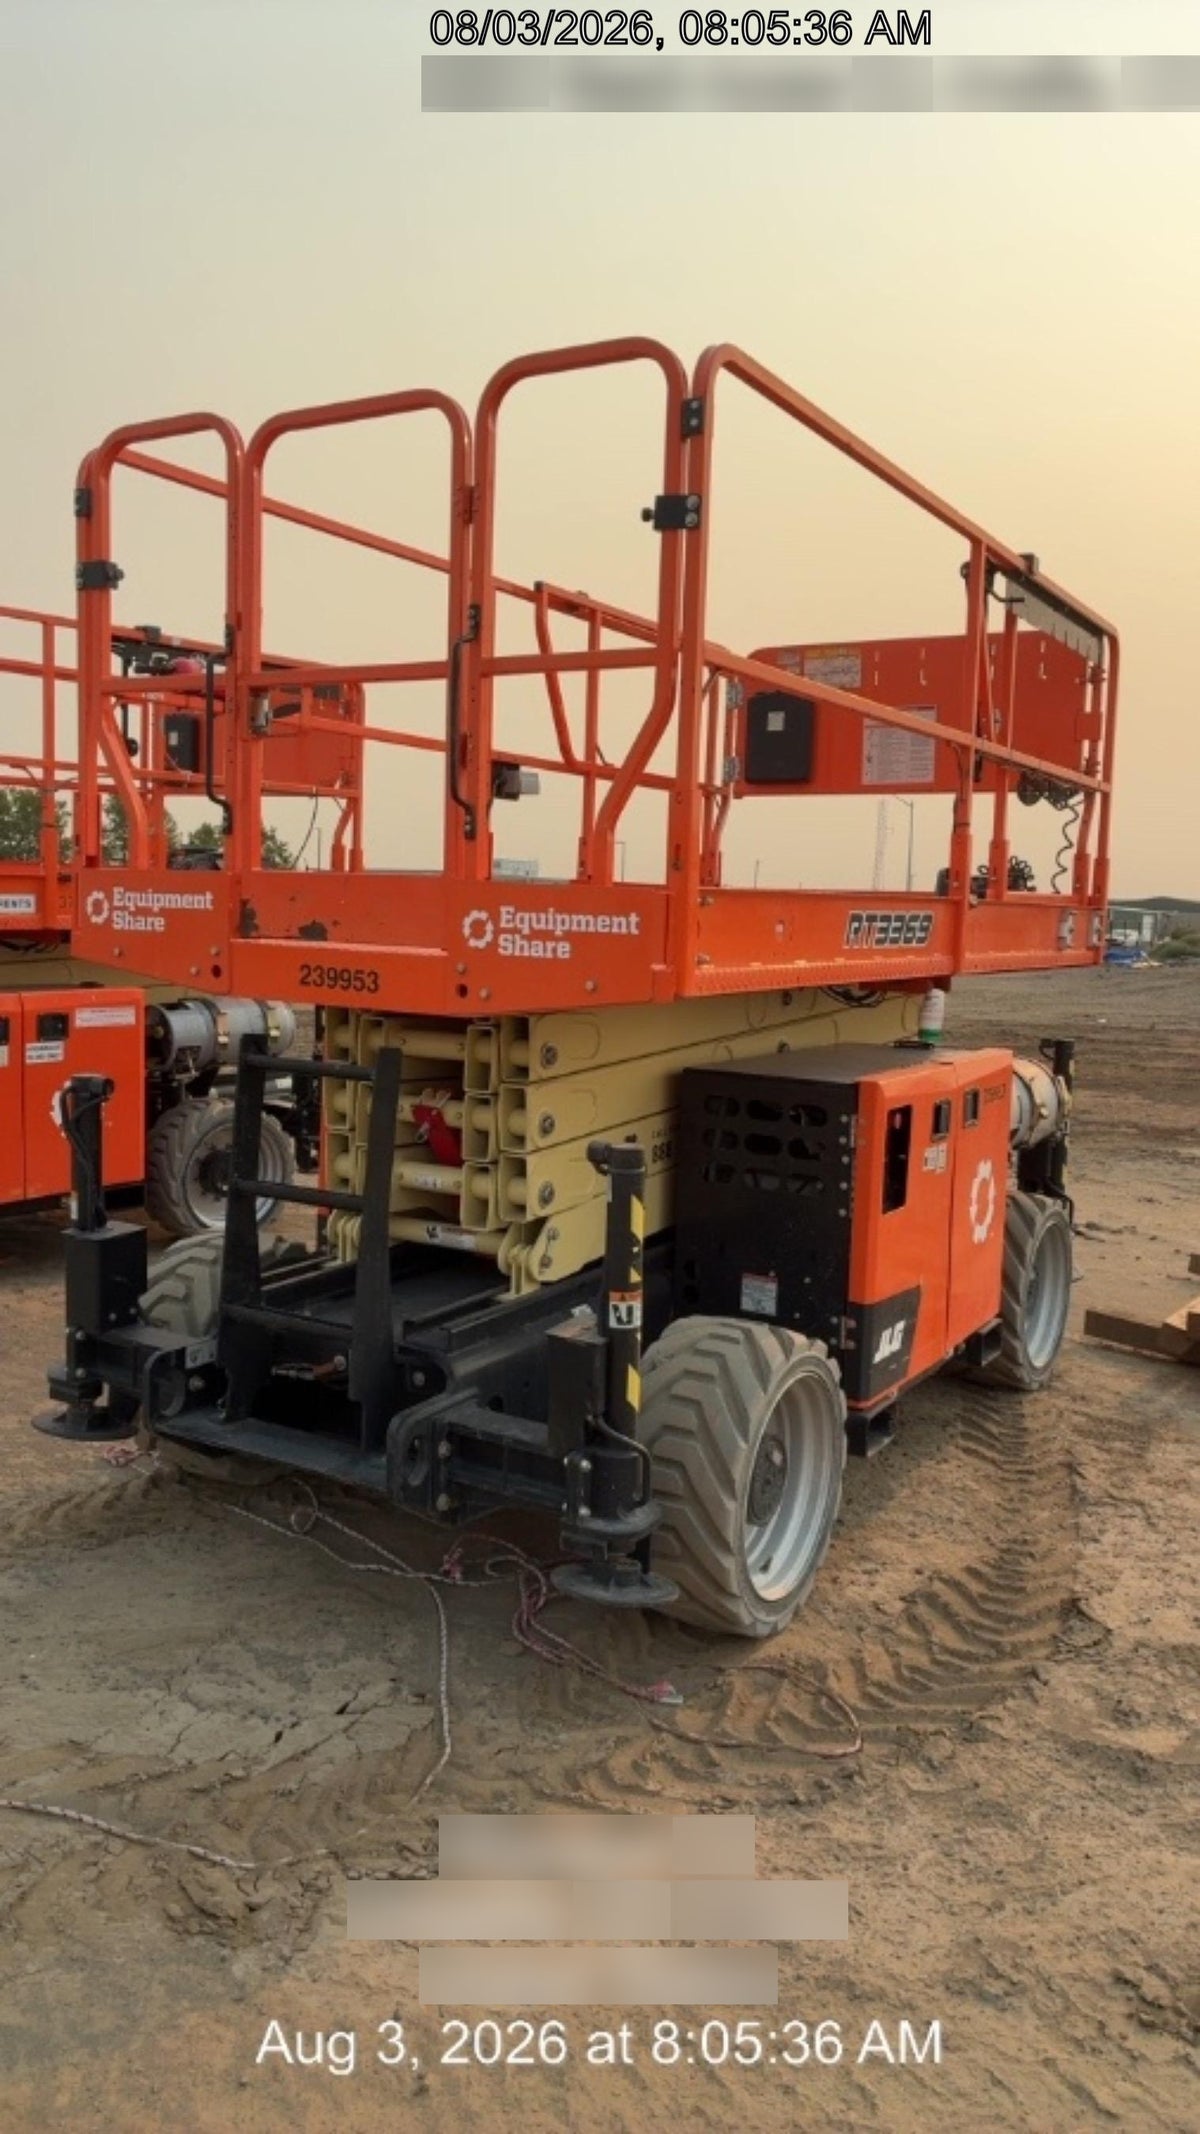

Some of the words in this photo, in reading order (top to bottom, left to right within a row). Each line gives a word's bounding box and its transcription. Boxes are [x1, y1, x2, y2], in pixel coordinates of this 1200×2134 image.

[112, 886, 214, 912] Equipment
[112, 910, 166, 932] Share
[499, 905, 641, 936] Equipment
[843, 910, 935, 949] RT3369
[497, 933, 571, 959] Share
[299, 964, 380, 994] 239953
[872, 1319, 907, 1365] JLG
